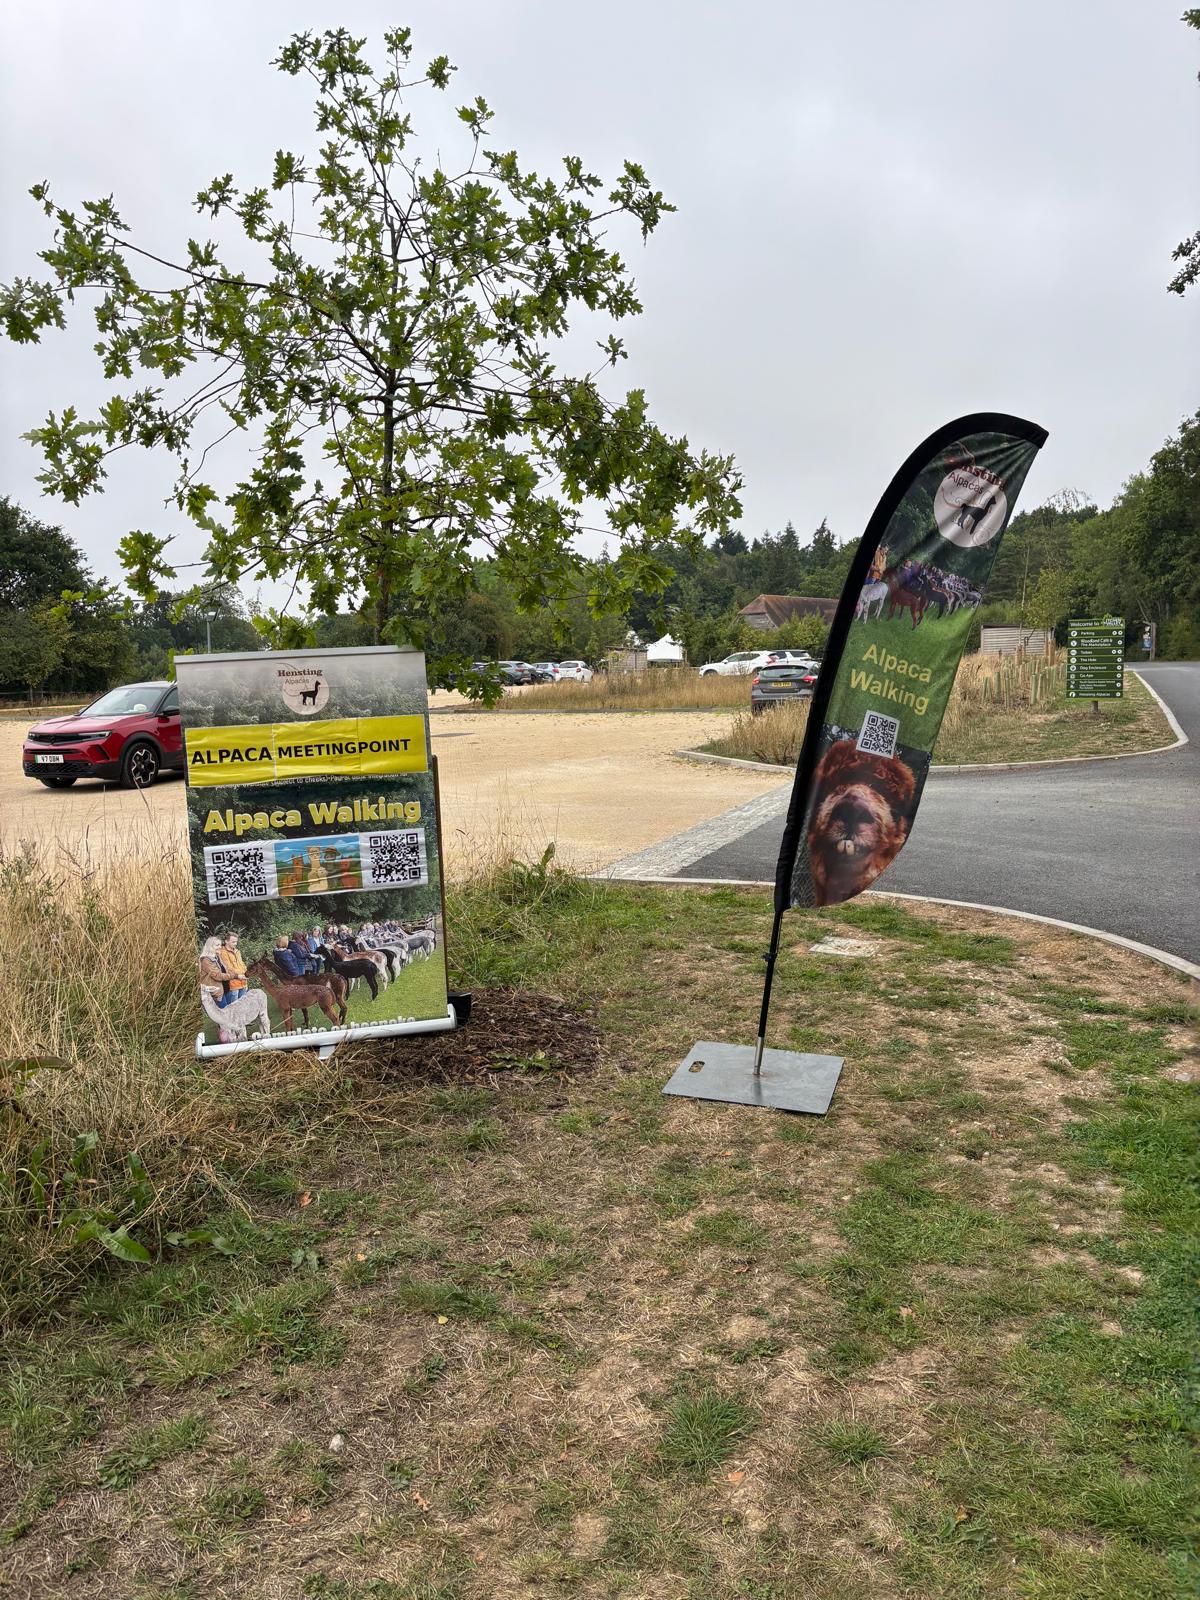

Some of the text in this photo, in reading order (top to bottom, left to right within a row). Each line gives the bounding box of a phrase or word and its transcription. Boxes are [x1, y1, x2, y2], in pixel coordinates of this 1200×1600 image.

[948, 472, 984, 494] Alpacas
[277, 668, 323, 677] Hensting
[862, 643, 932, 683] Alpaca
[284, 677, 309, 685] Alpacas
[850, 669, 930, 716] Walking
[191, 739, 411, 765] ALPACA MEETINGPOINT
[204, 797, 422, 836] Alpaca Walking
